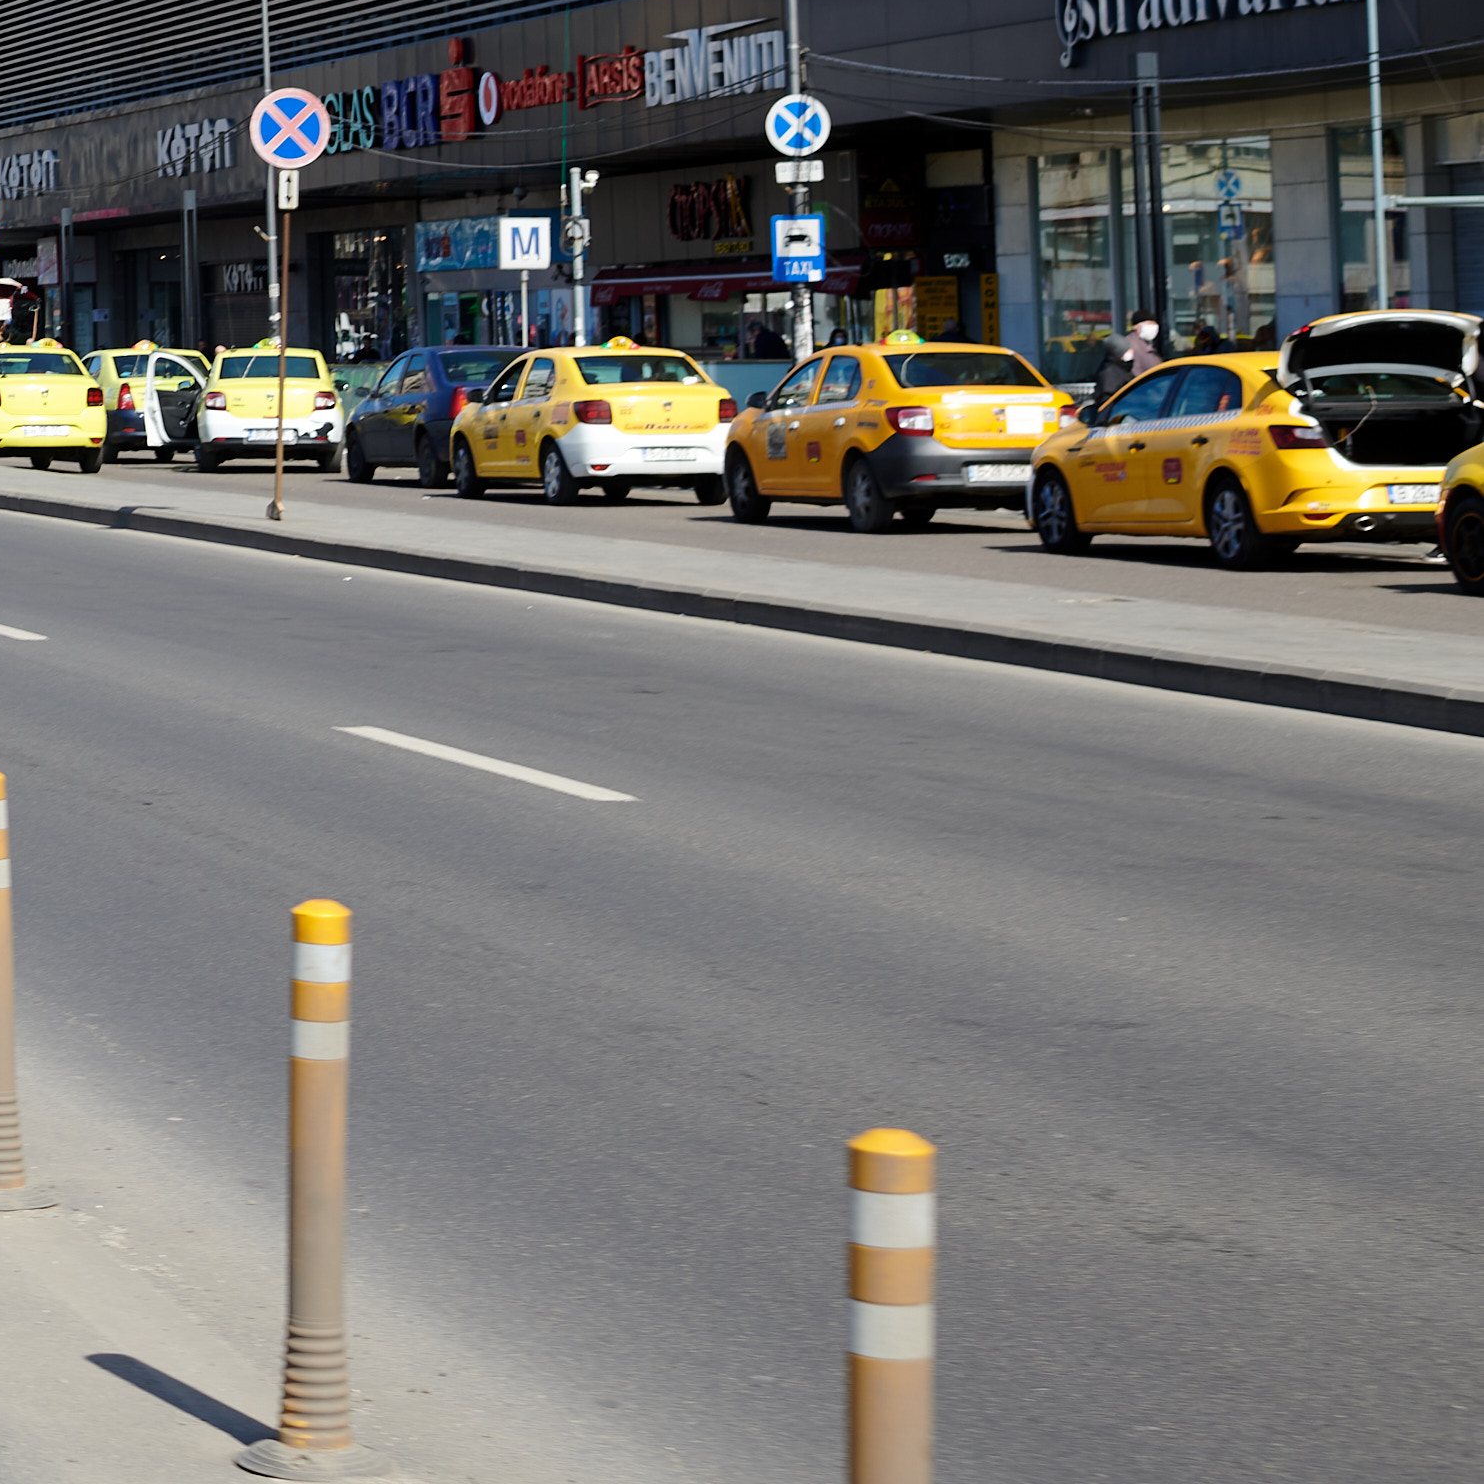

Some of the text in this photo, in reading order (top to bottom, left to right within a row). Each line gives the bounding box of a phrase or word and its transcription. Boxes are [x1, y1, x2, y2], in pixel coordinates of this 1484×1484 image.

[644, 18, 786, 108] BENVENUTI
[382, 74, 439, 150] BCR
[511, 227, 540, 260] M
